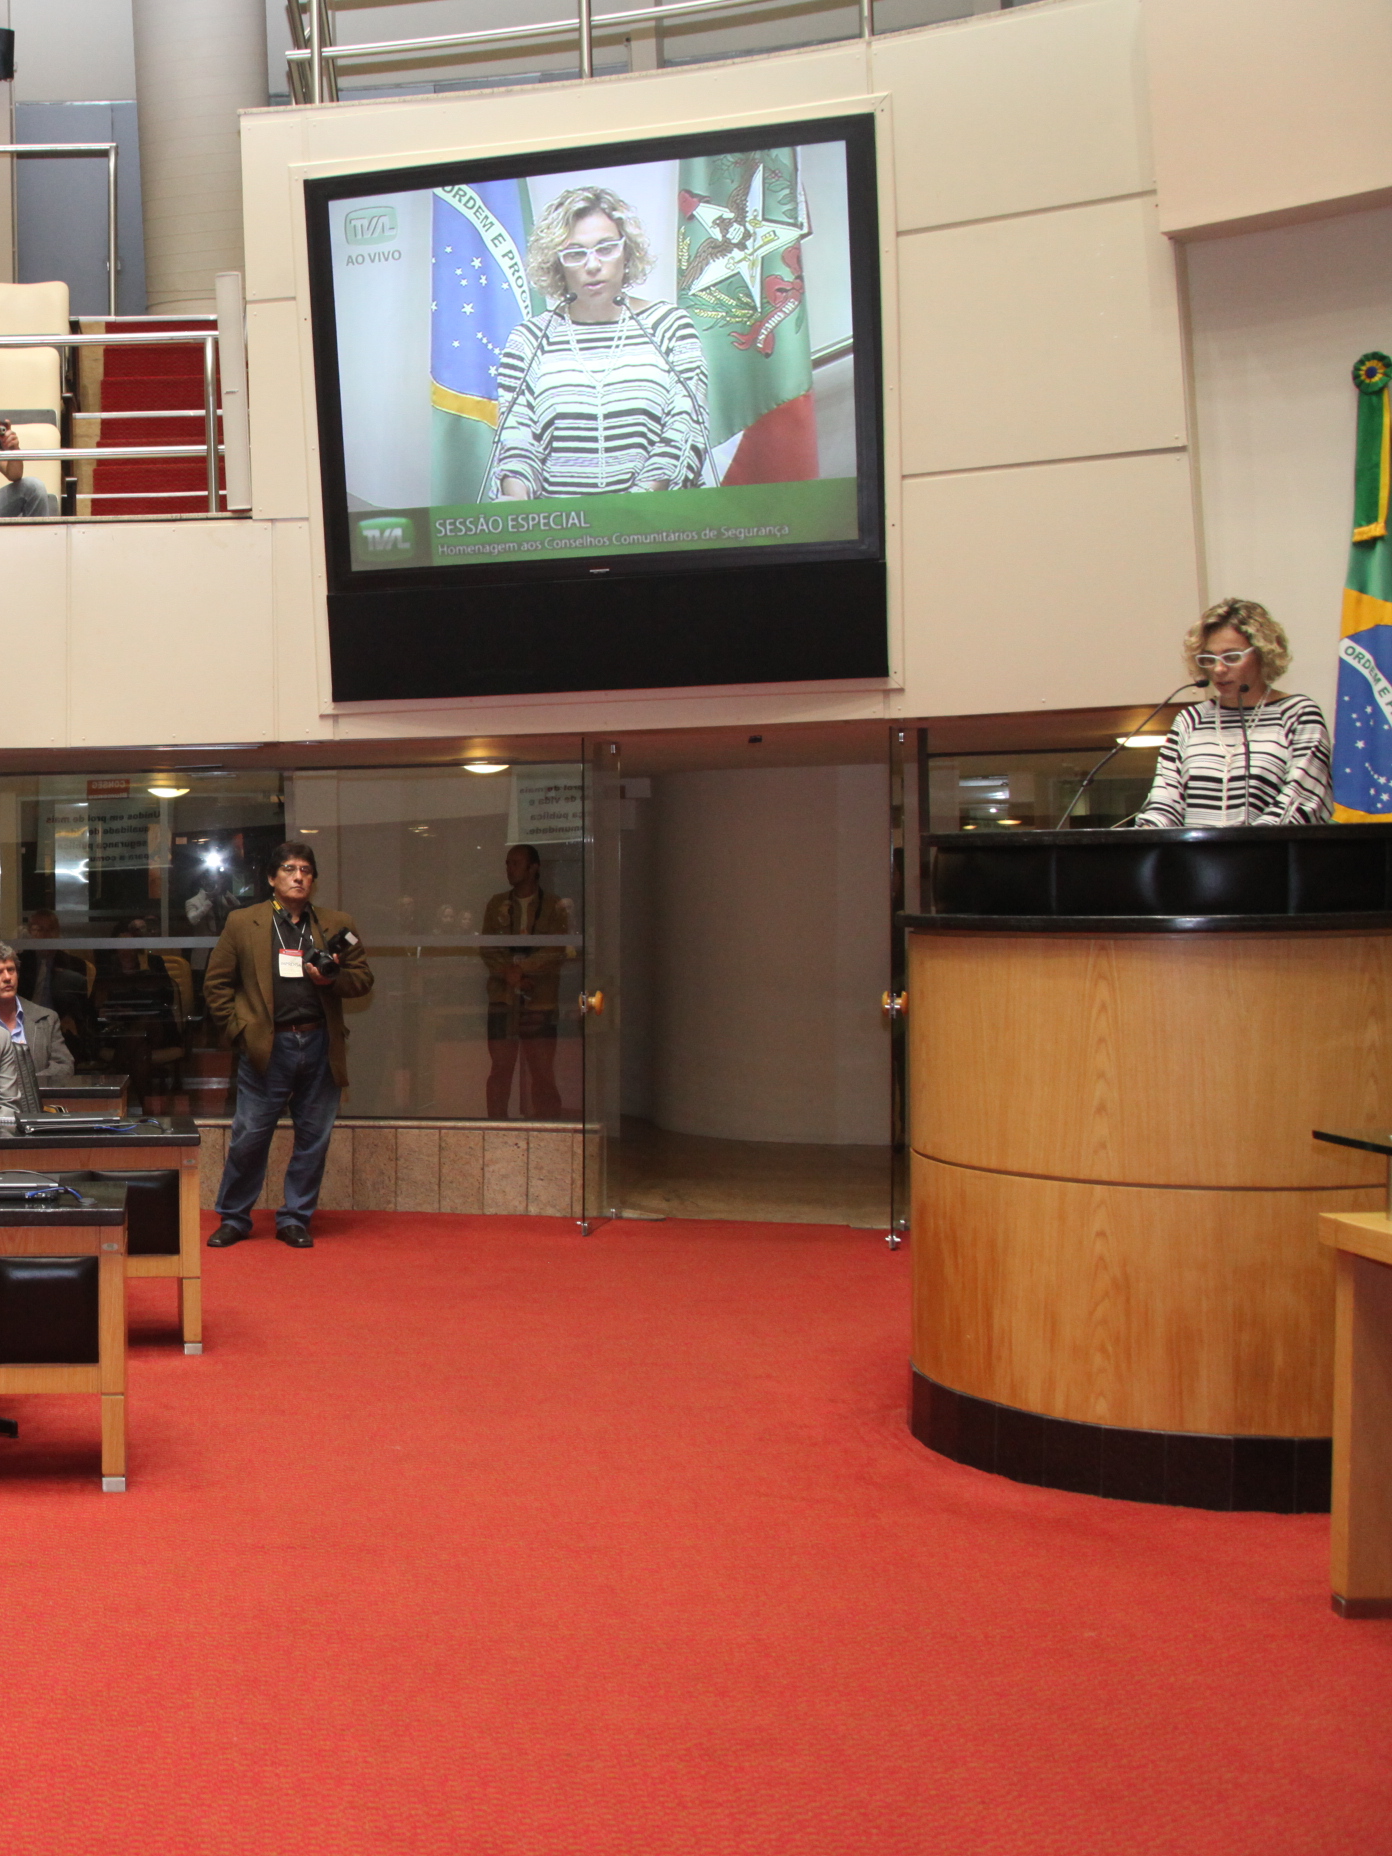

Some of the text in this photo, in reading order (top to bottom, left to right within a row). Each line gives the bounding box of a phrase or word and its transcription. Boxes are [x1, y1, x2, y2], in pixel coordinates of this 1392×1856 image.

[441, 186, 495, 233] ORDEM
[490, 232, 506, 248] E
[346, 250, 402, 266] AO VIVO
[435, 510, 591, 537] SESSÃO ESPECIAL
[438, 523, 790, 557] Homenagem aos Conselhos Comunitários de Segurança
[1344, 645, 1391, 698] ORDEM E
